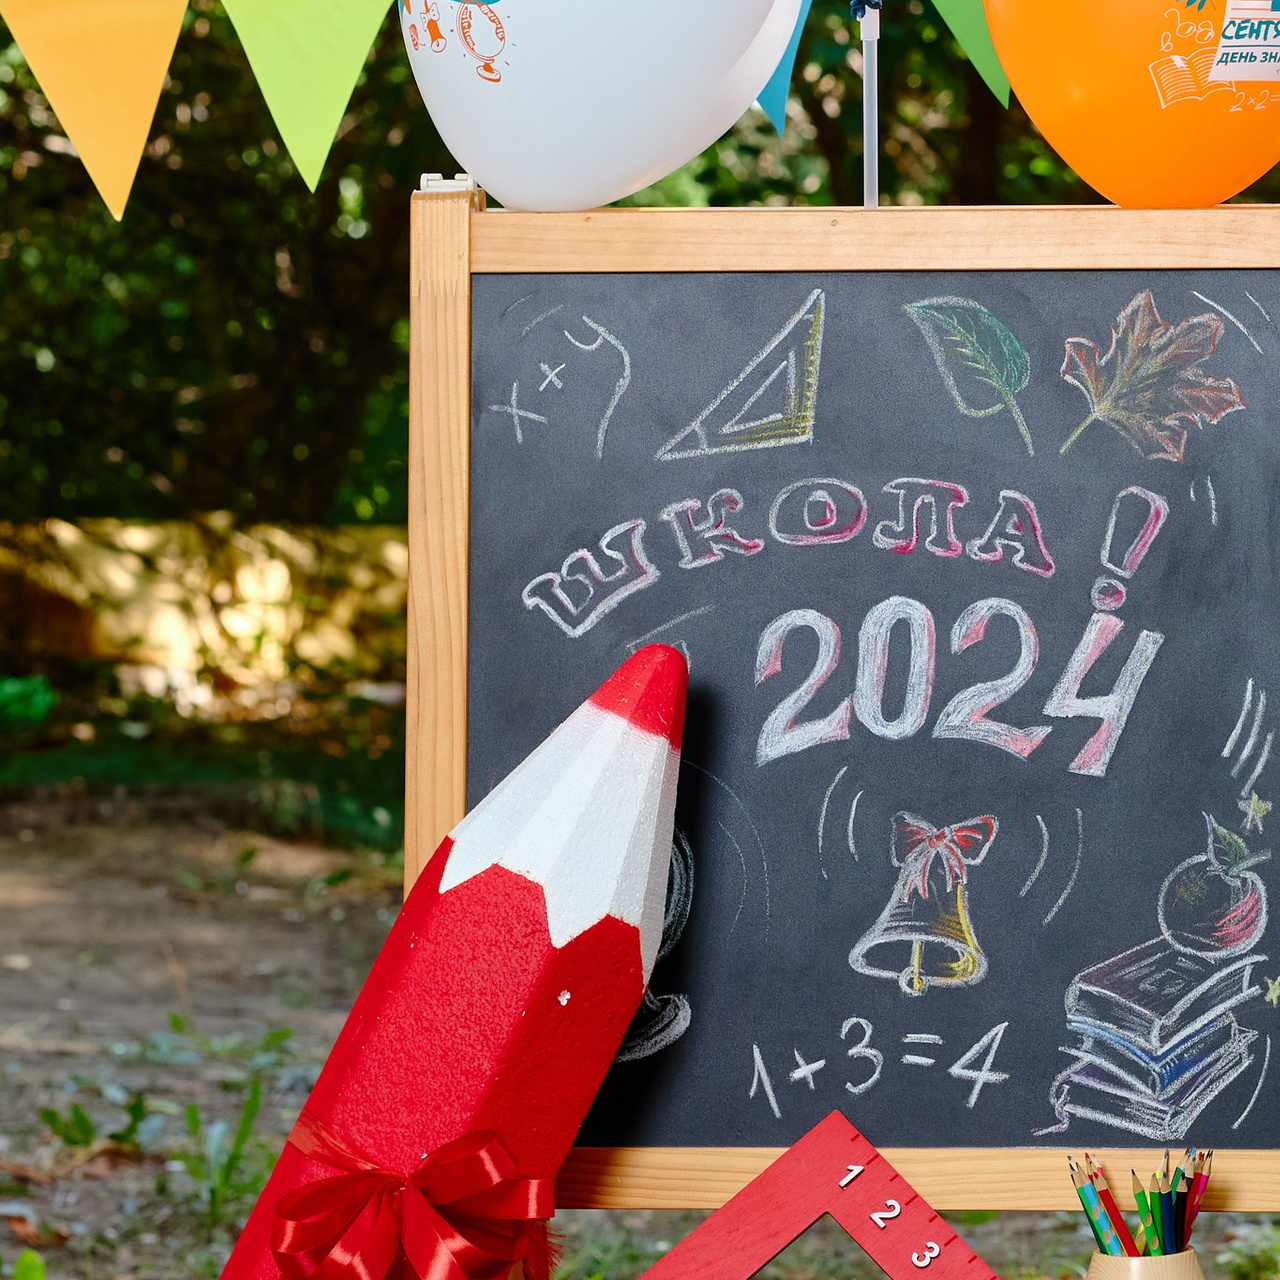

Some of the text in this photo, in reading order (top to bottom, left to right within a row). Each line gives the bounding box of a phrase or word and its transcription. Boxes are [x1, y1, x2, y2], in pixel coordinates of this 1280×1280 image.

[1216, 51, 1257, 66] ДЕНЬ
[754, 596, 1165, 777] 2024
[839, 1164, 865, 1188] 1
[869, 1199, 901, 1229] 2
[911, 1241, 940, 1268] 3
